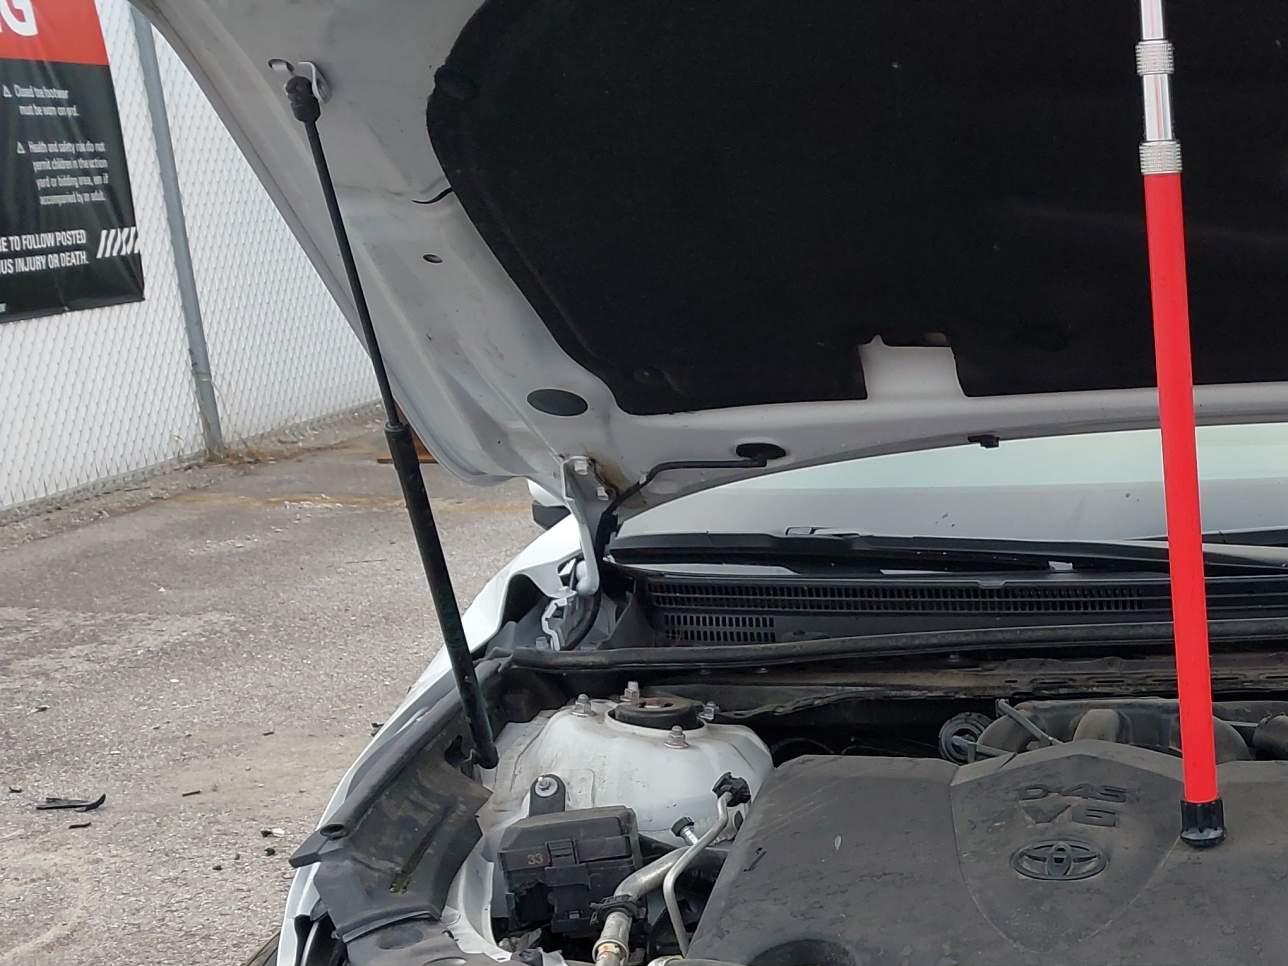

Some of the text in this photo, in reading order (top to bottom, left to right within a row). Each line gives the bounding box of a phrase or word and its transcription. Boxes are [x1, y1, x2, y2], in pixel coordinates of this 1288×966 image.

[0, 236, 9, 251] E
[8, 235, 21, 251] TO
[21, 232, 55, 250] FOLLOW
[55, 229, 86, 246] POSTED
[0, 251, 89, 274] US INJURY OR DEATH.
